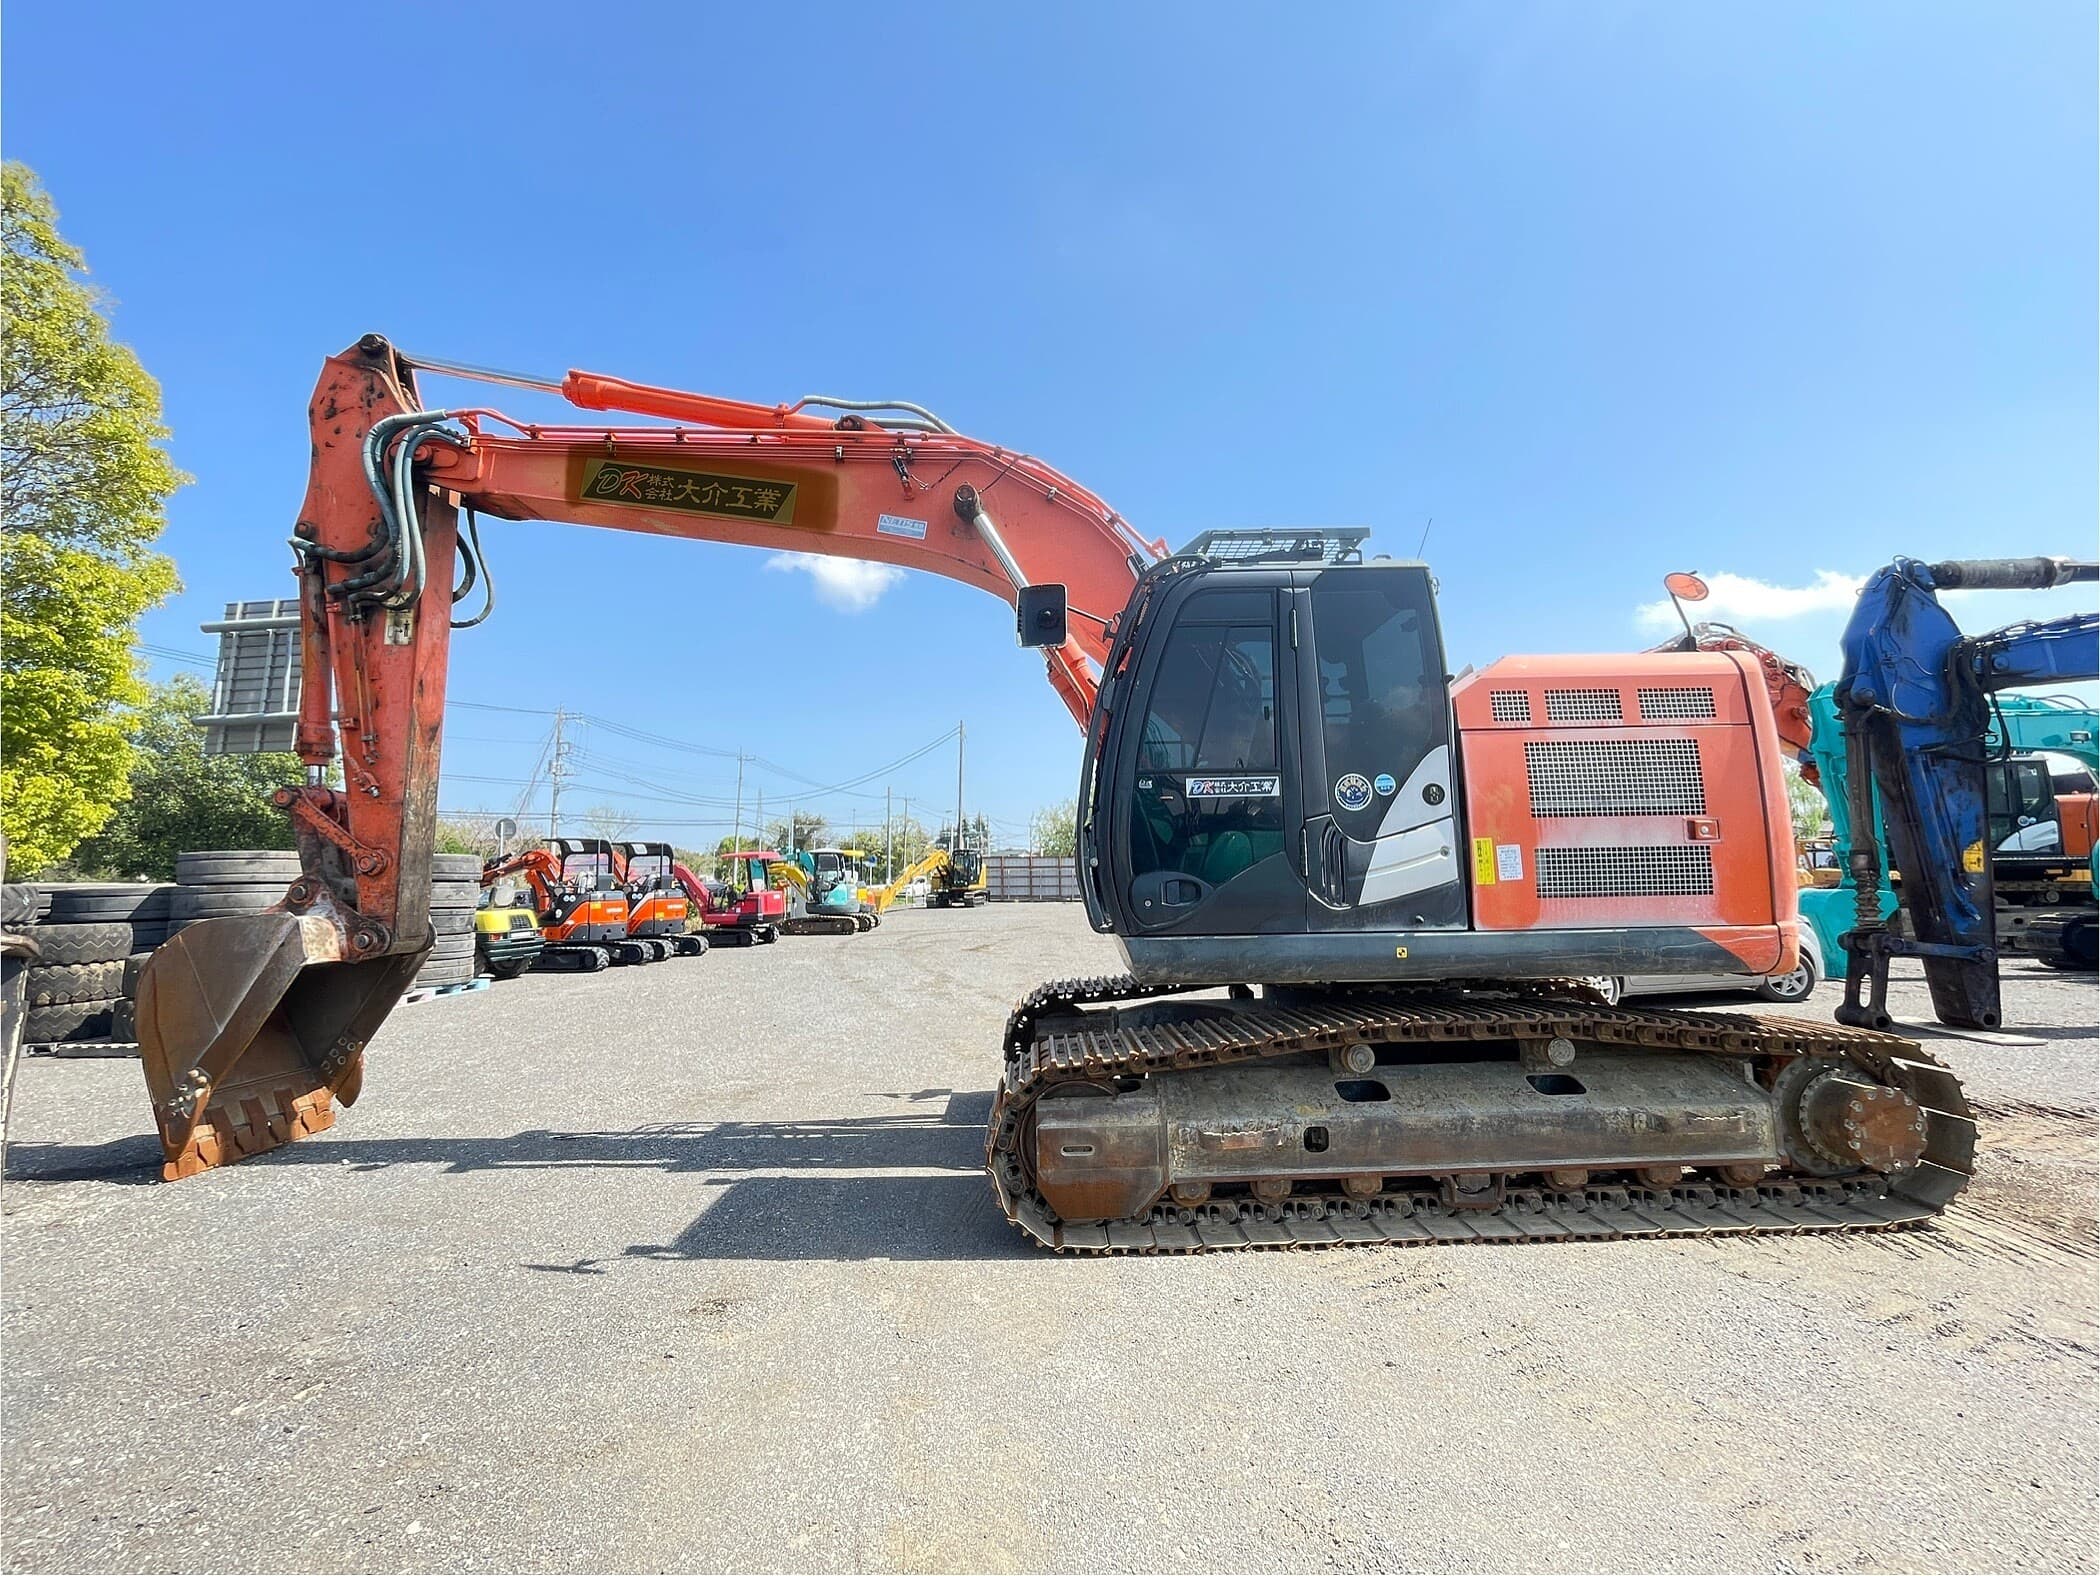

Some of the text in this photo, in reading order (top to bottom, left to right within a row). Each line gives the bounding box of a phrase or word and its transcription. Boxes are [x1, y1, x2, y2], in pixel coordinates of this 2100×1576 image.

[596, 467, 649, 500] DK
[649, 473, 675, 489] 株式
[644, 487, 673, 502] 会社
[673, 479, 782, 513] 大介工業
